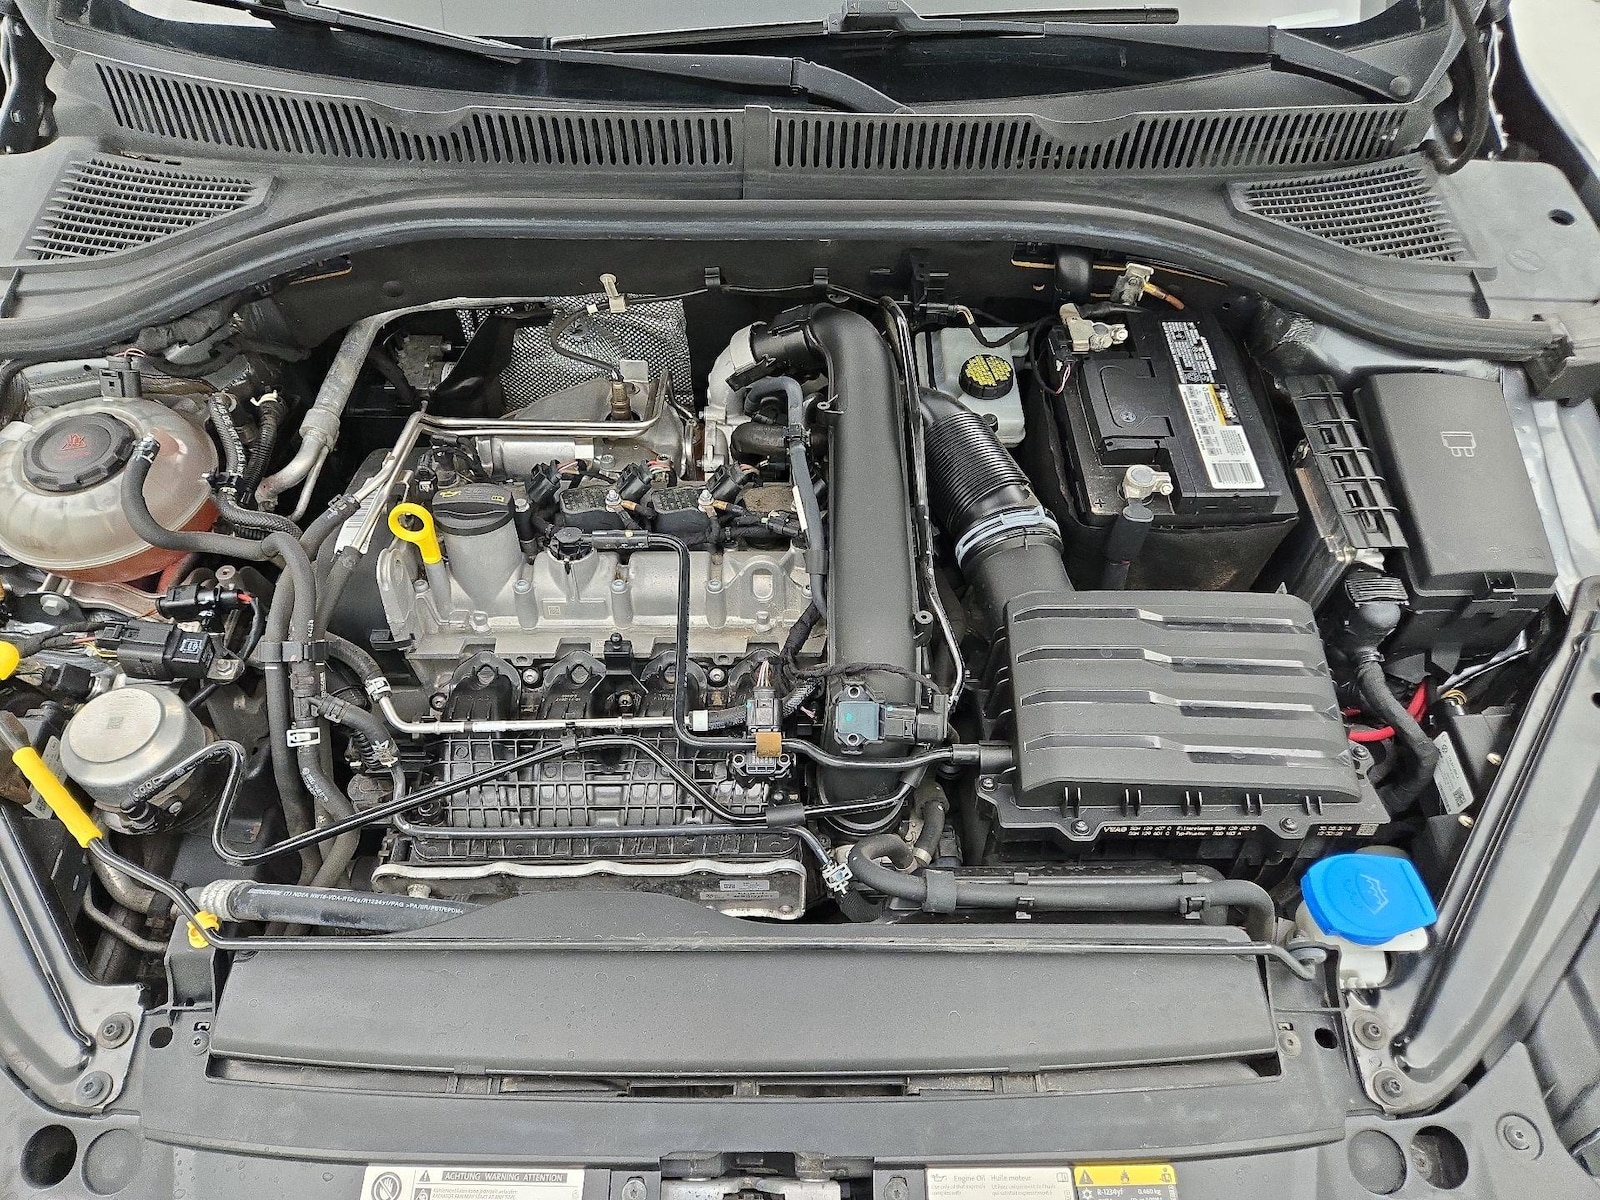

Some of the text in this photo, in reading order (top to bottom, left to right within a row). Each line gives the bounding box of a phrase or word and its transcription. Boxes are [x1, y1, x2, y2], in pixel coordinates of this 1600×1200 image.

[444, 1171, 563, 1182] ACHTUNG WARNING ATTENTION
[953, 1175, 975, 1184] Engine
[1097, 1188, 1123, 1197] R-1234yf
